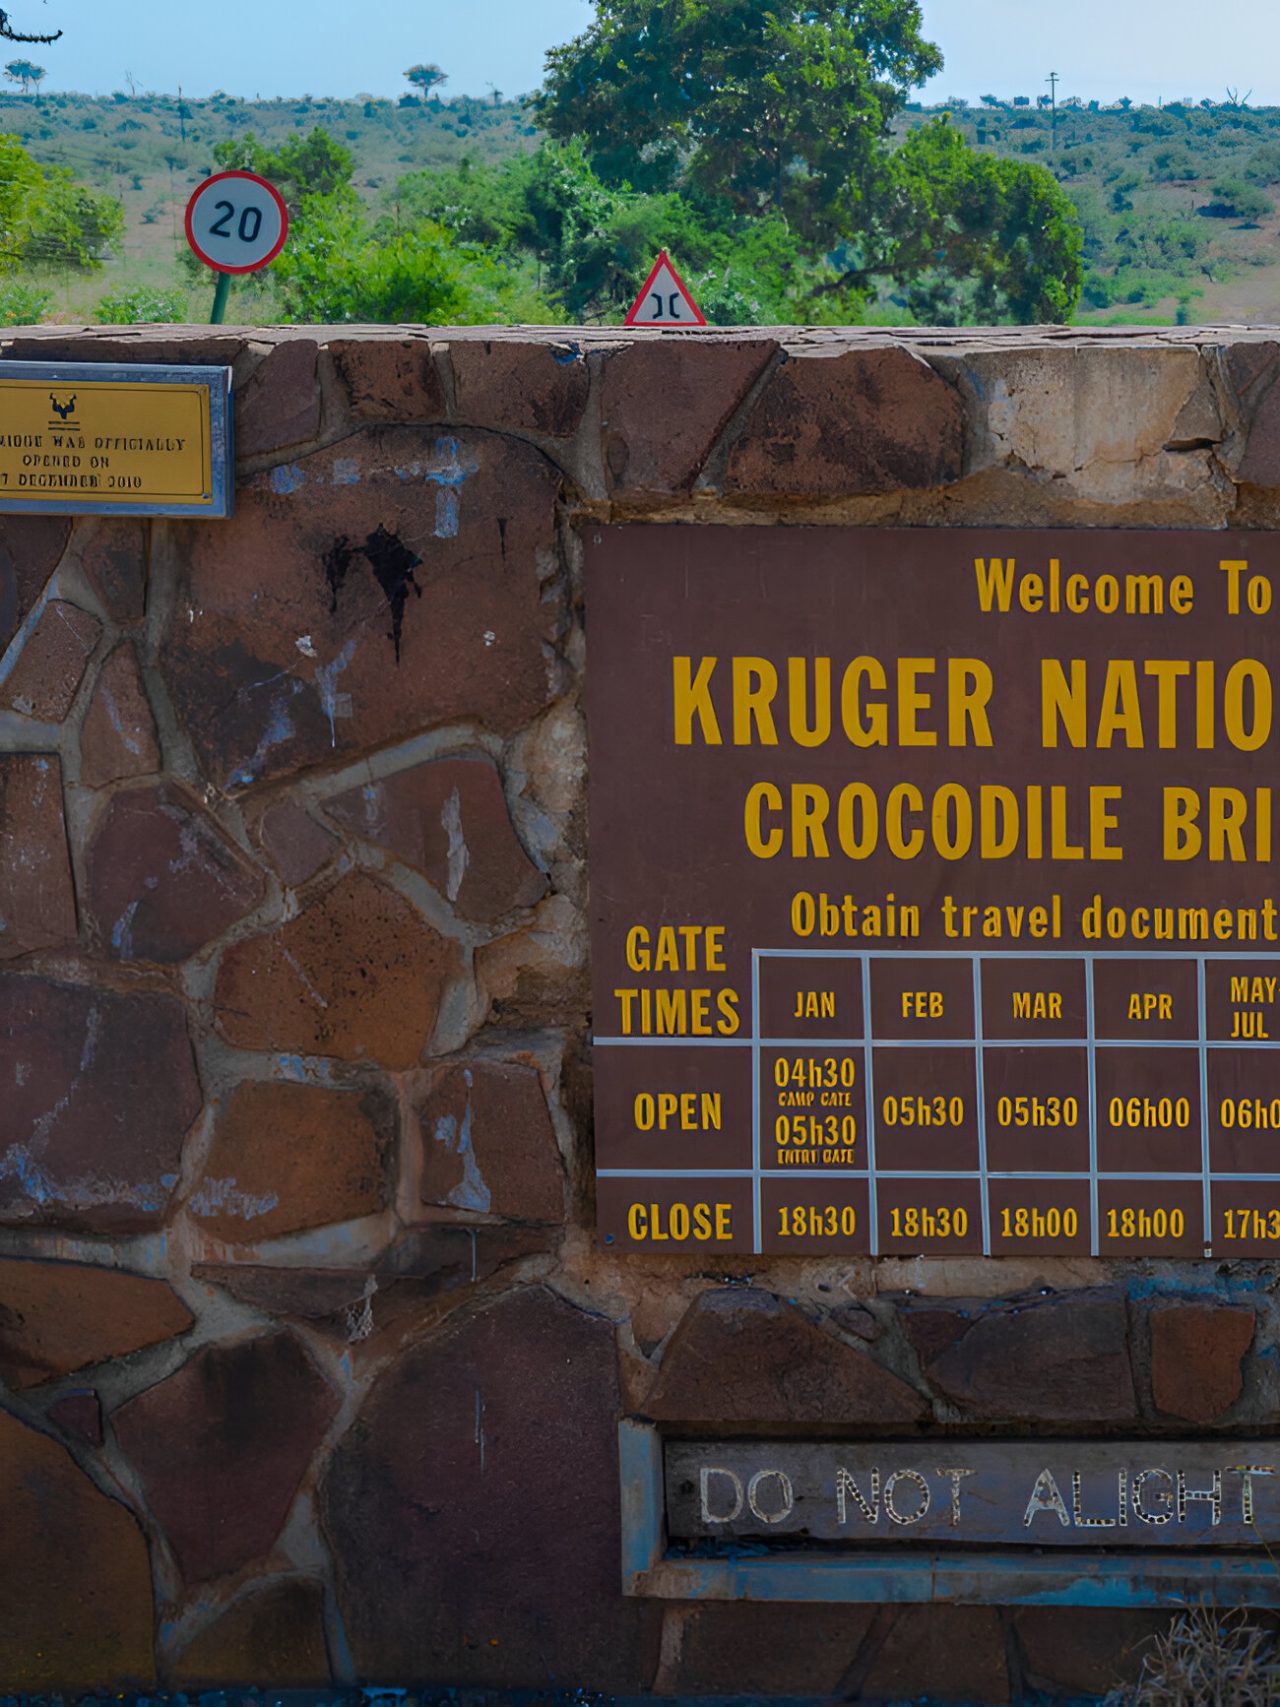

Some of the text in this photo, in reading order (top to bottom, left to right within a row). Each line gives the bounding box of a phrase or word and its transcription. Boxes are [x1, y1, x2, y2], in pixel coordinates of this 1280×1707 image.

[209, 200, 262, 242] 20
[107, 476, 142, 488] 2010
[975, 558, 1193, 614] Welcome
[1219, 560, 1272, 615] To
[673, 656, 993, 747] KRUGER
[744, 782, 1123, 860] CROCODILE
[791, 891, 919, 936] Obtain
[941, 895, 1061, 938] travel
[1082, 895, 1278, 940] document
[626, 926, 726, 972] GATE
[614, 988, 739, 1035] TIMES
[794, 992, 835, 1018] JAN
[902, 992, 943, 1018] FEB
[1013, 992, 1062, 1019] MAR
[1128, 993, 1172, 1020] APR
[1231, 1012, 1269, 1038] JUL
[775, 1058, 855, 1087] 04h30
[634, 1093, 721, 1131] OPEN
[778, 1092, 814, 1106] CAMP
[883, 1096, 963, 1126] 05h30
[998, 1096, 1077, 1126] 05h30
[1109, 1097, 1189, 1127] 06h00
[776, 1115, 856, 1145] 05h30
[628, 1203, 733, 1240] CLOSE
[778, 1206, 855, 1236] 18h30
[891, 1207, 967, 1237] 18h30
[1001, 1208, 1077, 1237] 18h00
[1107, 1208, 1184, 1238] 18h00
[699, 1467, 794, 1524] DO
[835, 1467, 976, 1526] NOT
[1023, 1465, 1276, 1528] ALIGHT
